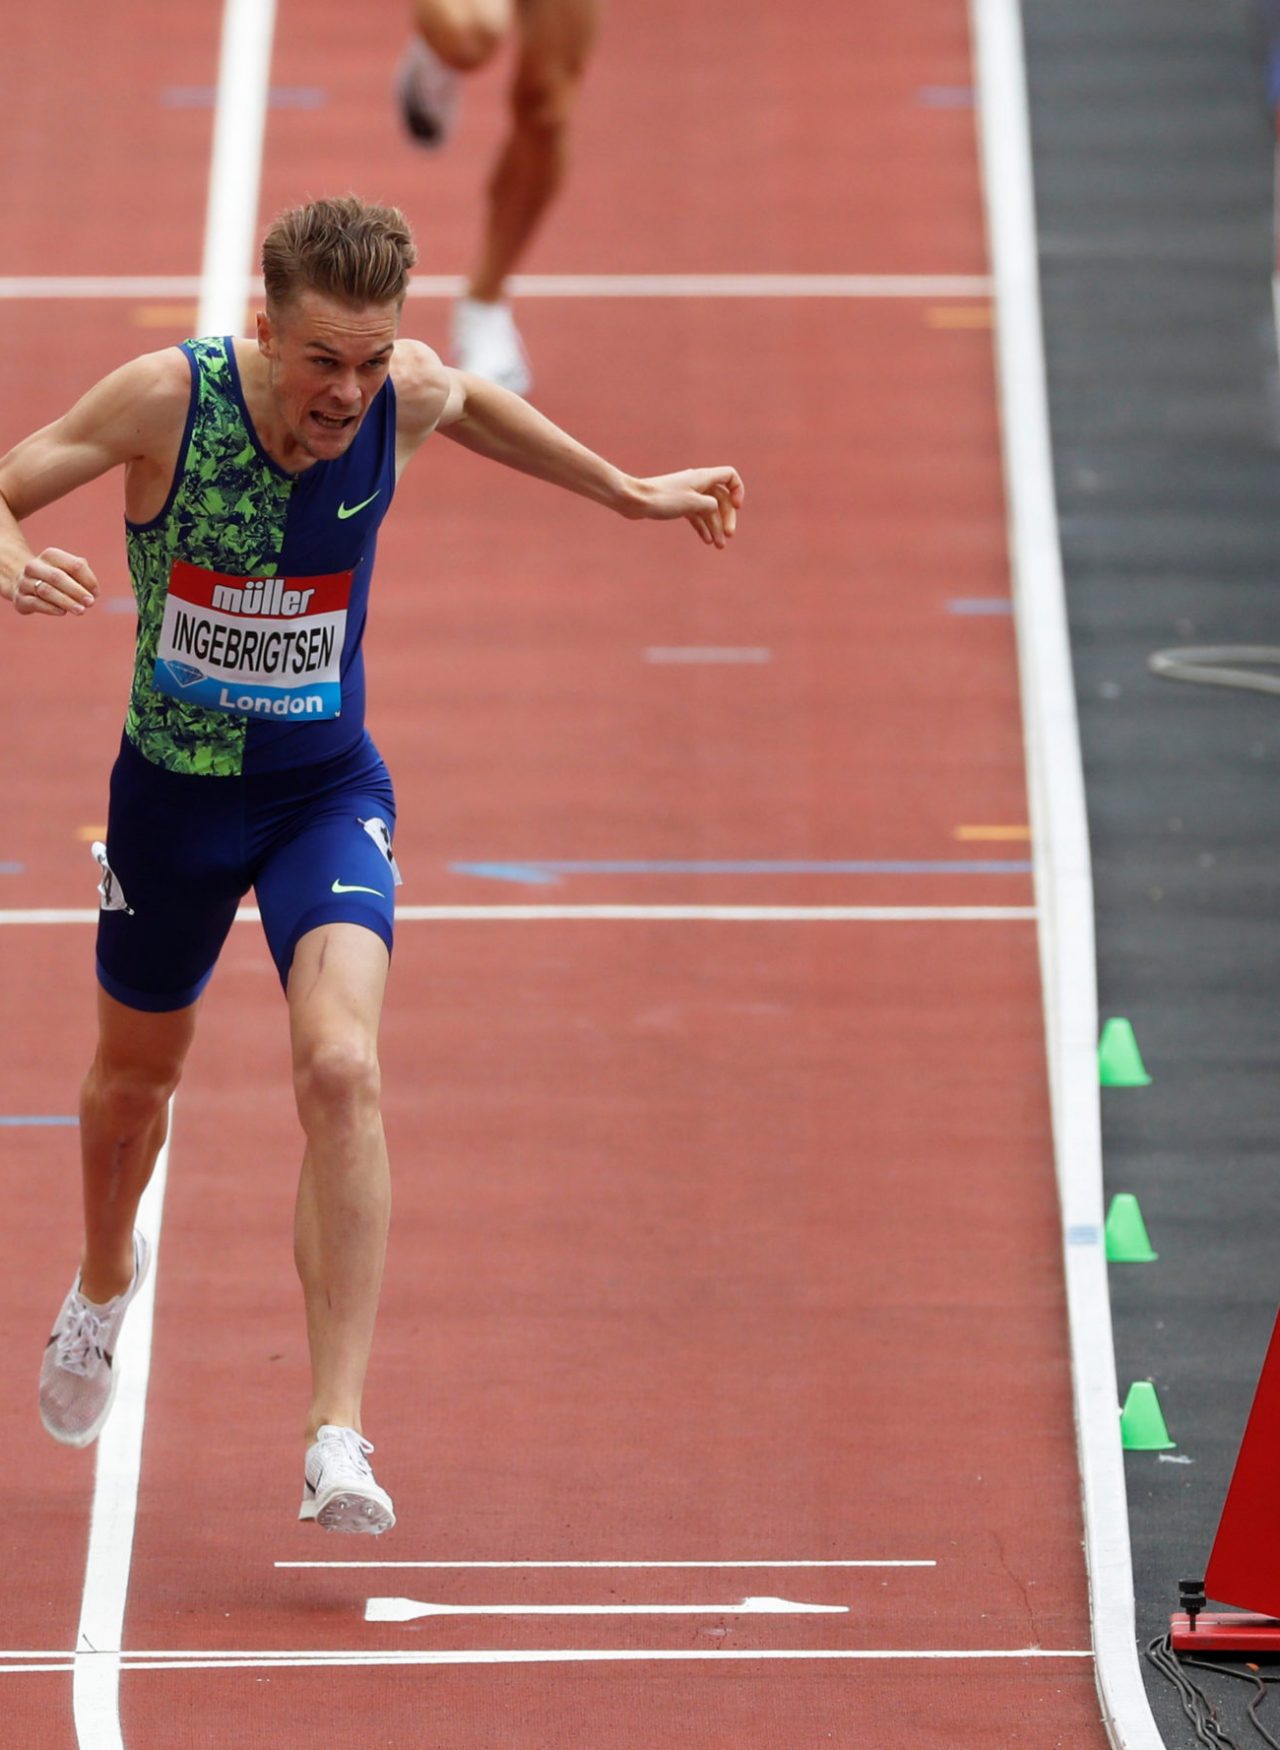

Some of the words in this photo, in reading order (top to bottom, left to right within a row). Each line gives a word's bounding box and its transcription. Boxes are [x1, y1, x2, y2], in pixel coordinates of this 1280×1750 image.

[212, 579, 315, 616] müller
[172, 611, 335, 674] INGEBRIGTSEN
[220, 688, 323, 715] London
